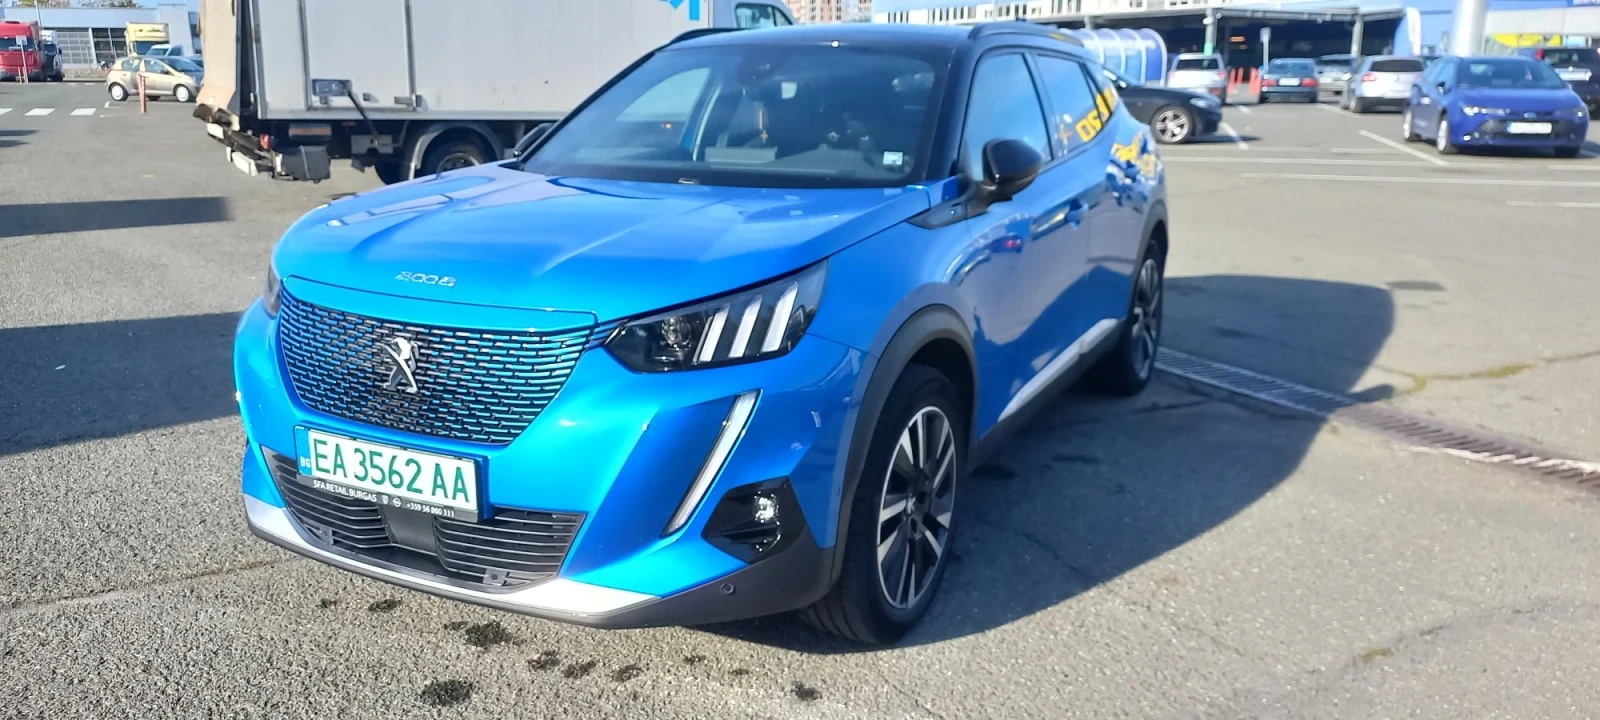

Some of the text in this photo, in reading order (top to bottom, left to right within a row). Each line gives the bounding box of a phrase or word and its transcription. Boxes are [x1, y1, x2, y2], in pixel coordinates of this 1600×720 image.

[395, 271, 457, 287] 2008
[300, 456, 311, 468] BG
[313, 438, 470, 503] EA 3562 AA
[313, 480, 377, 502] SFA RETAIL BURGAS
